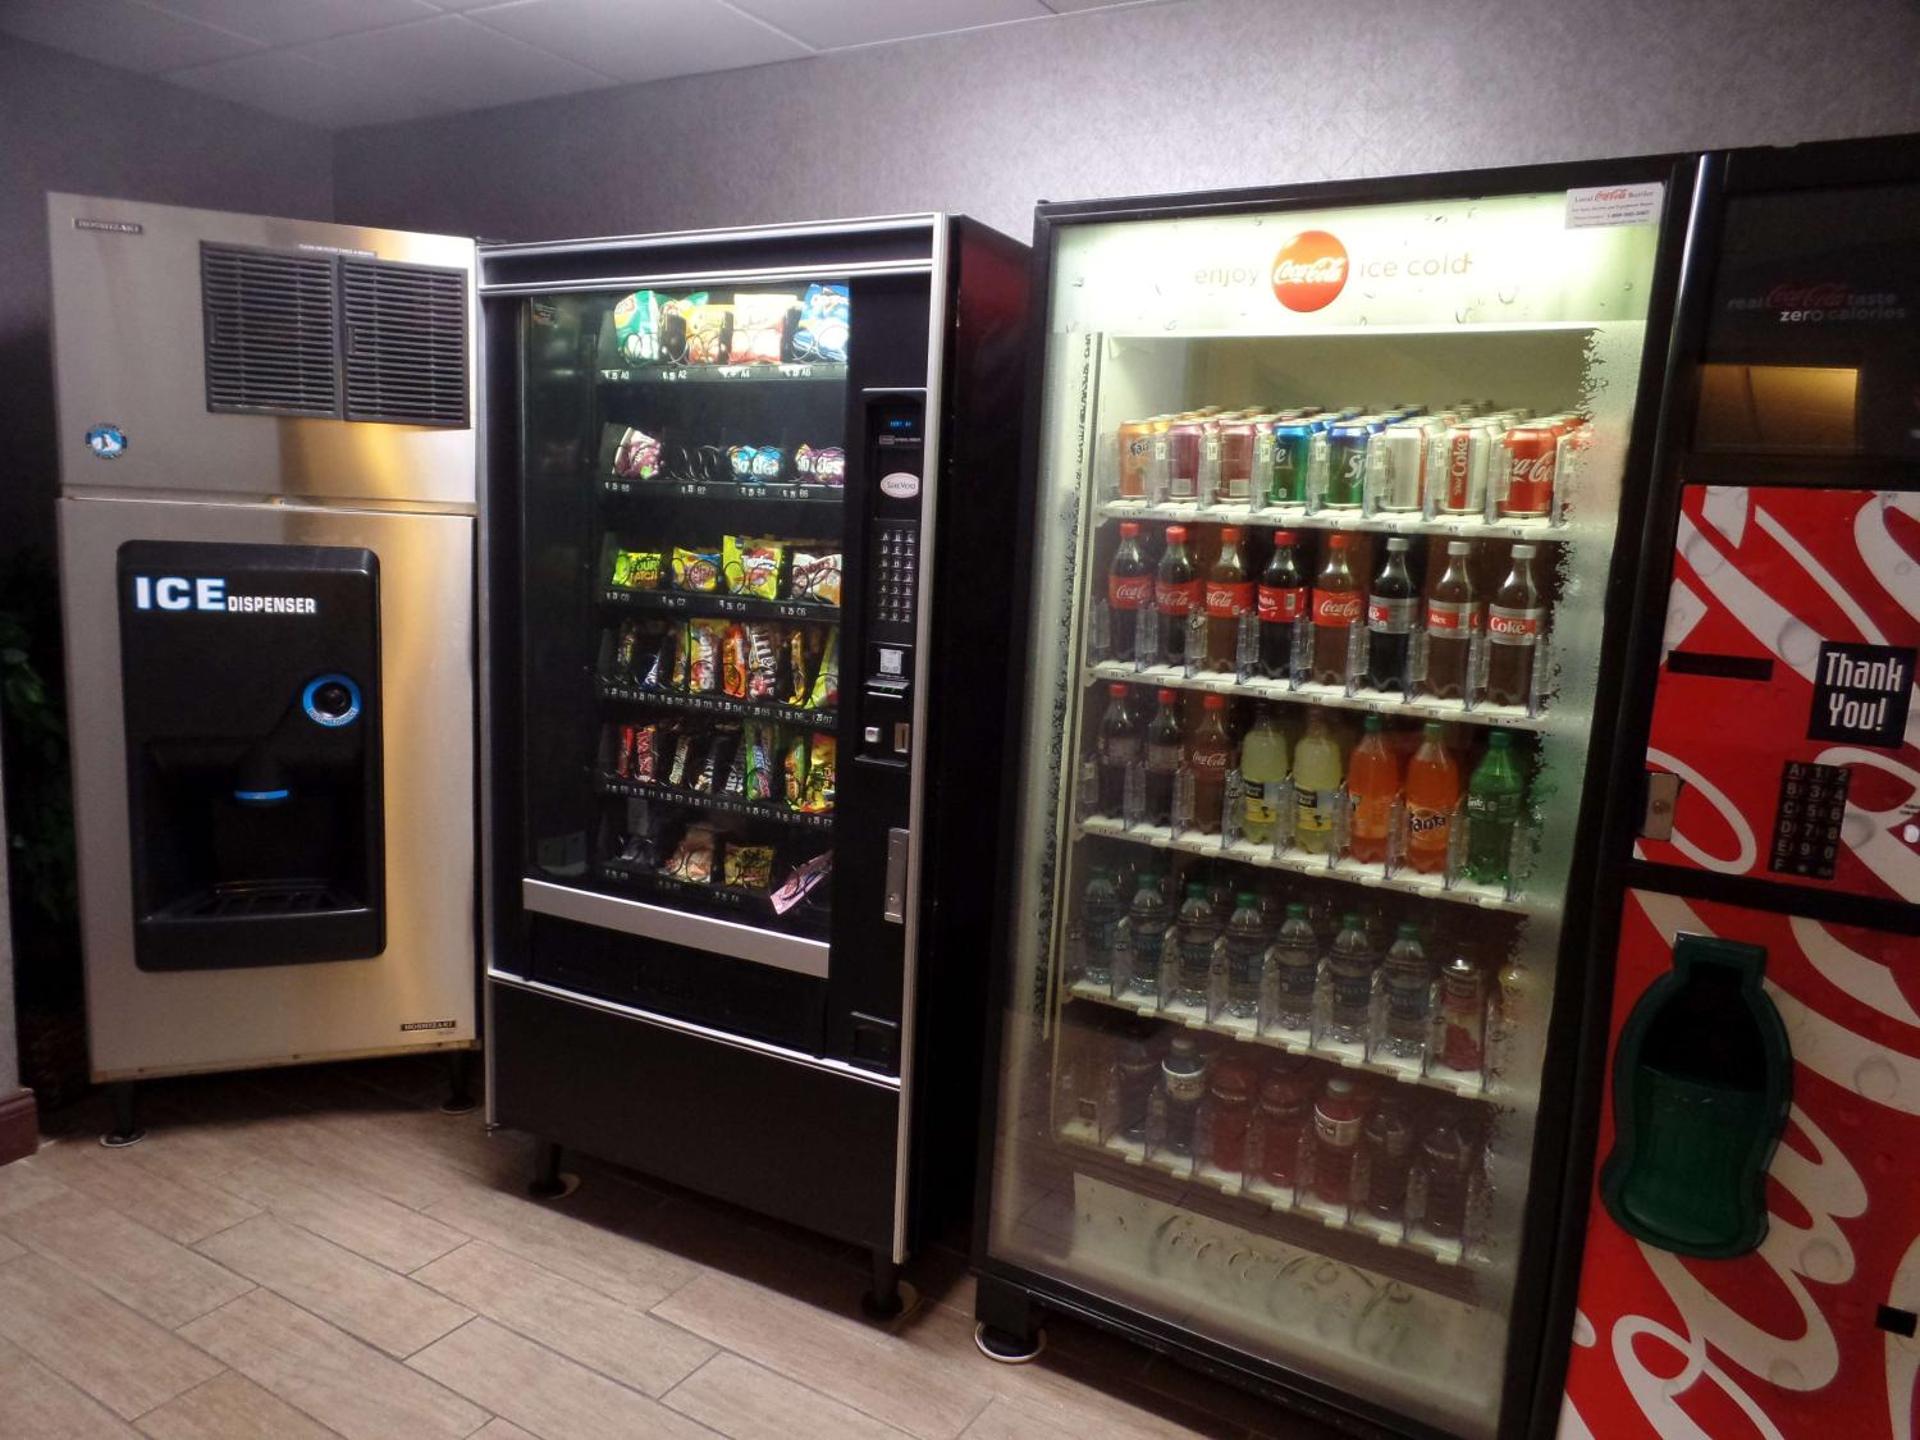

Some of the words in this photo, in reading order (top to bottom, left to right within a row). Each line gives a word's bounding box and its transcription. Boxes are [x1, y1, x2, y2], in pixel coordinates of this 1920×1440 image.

[1194, 266, 1260, 288] enjoy
[1274, 256, 1346, 284] Coca-Cola
[1360, 260, 1398, 278] ice
[1407, 252, 1473, 276] cold
[1780, 310, 1824, 322] zero
[1827, 306, 1905, 320] calories
[1453, 437, 1469, 476] Coke
[136, 577, 226, 610] ICE
[228, 596, 316, 613] DISPENSER
[1490, 616, 1527, 635] Coke
[1826, 652, 1903, 693] Thank
[1829, 693, 1887, 731] You!
